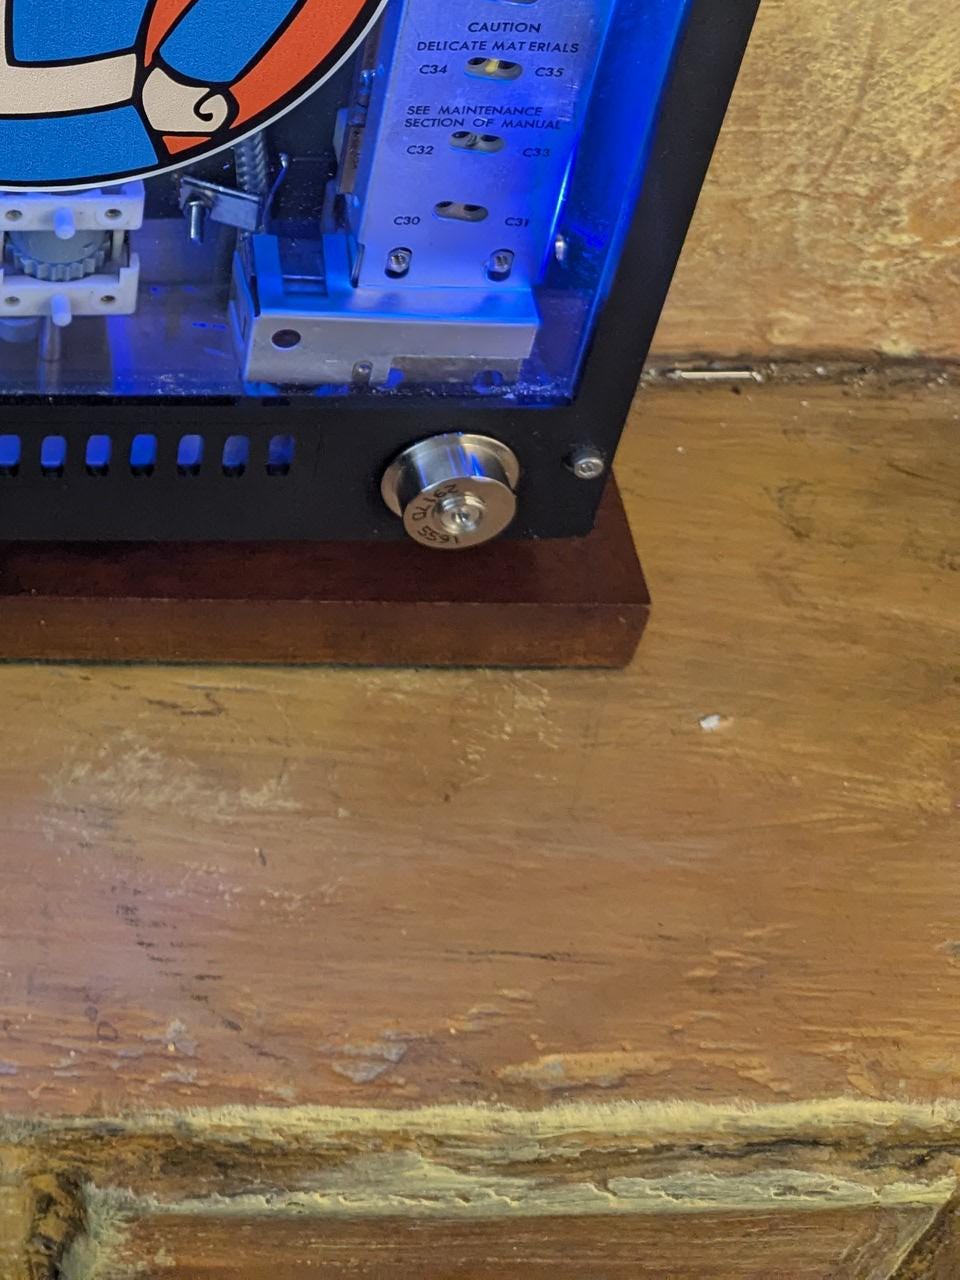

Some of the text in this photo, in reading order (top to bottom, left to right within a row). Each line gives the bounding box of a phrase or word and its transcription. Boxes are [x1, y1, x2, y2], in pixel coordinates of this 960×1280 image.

[467, 21, 542, 34] CAUTION
[416, 40, 580, 54] DELICATE MATERIALS
[418, 64, 448, 75] C34
[534, 66, 564, 78] C35
[407, 104, 543, 118] SEE MAINTENANCE
[404, 117, 562, 131] SECTION OF MANUAL
[406, 144, 434, 156] C32
[522, 147, 551, 158] C33
[393, 215, 421, 226] C30
[504, 216, 529, 228] C31
